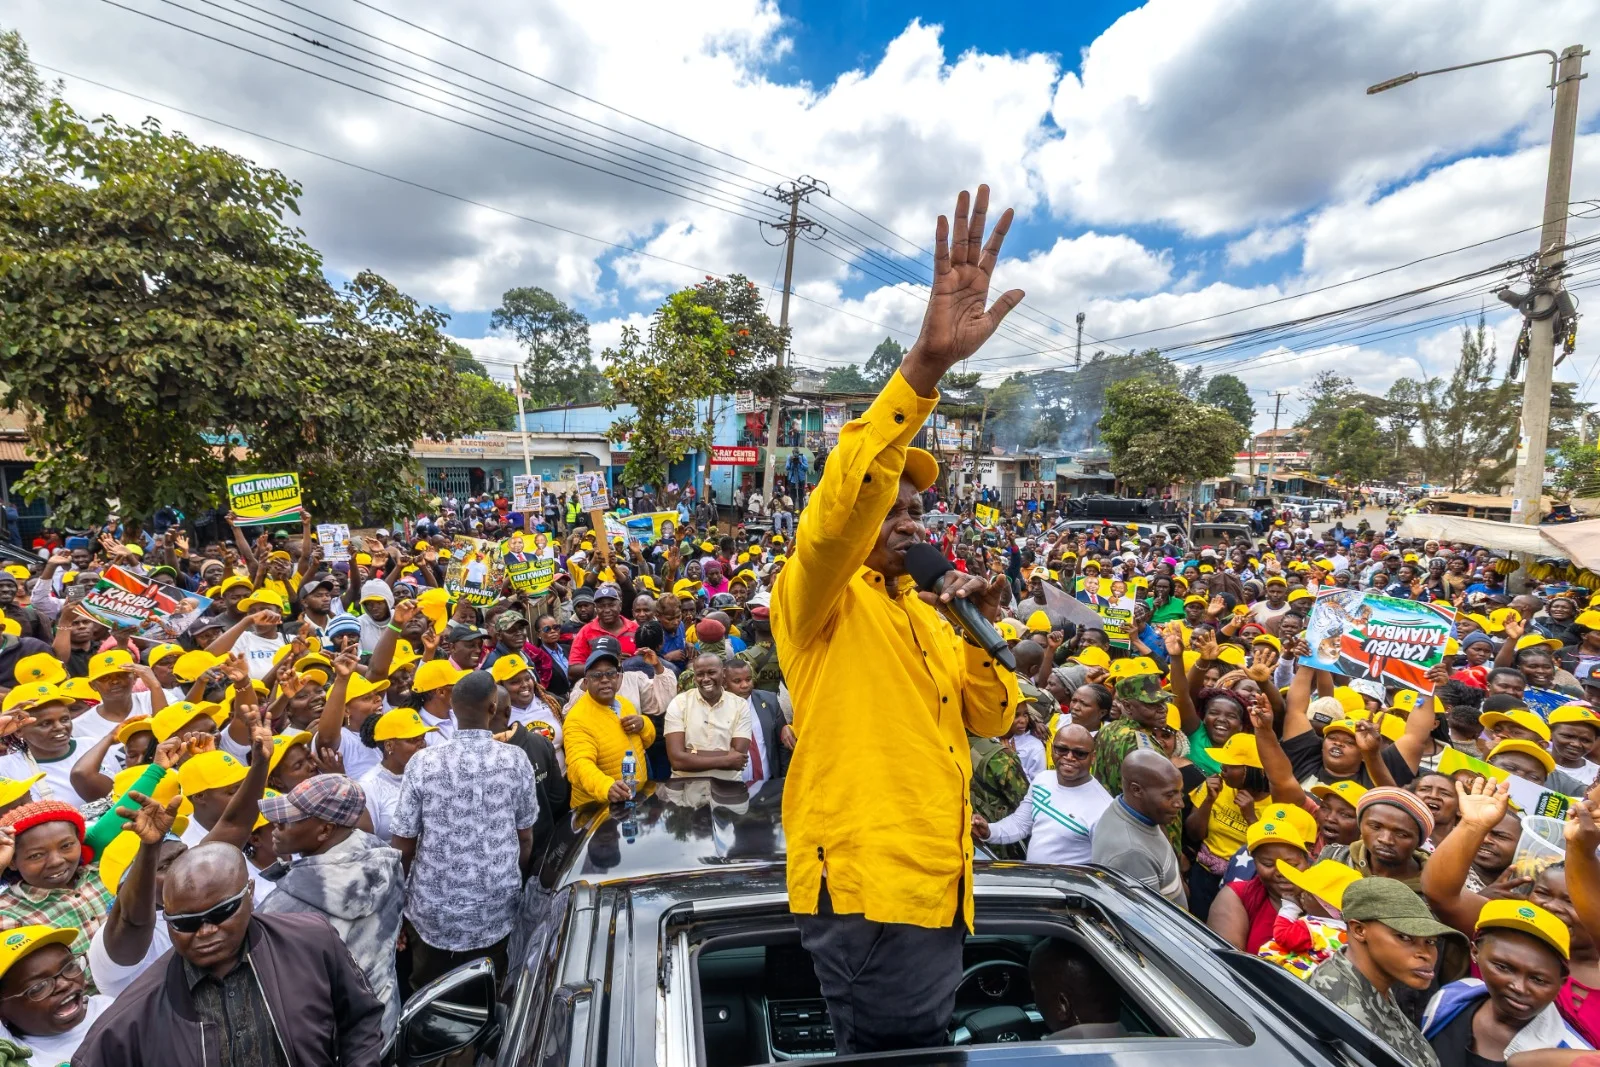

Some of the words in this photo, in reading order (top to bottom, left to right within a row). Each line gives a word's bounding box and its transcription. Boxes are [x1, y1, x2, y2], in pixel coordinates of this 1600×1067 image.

[733, 450, 756, 458] CENTER
[232, 481, 255, 495] KAZI
[256, 475, 294, 491] KWANZA
[235, 493, 261, 508] SIASA
[262, 487, 297, 503] BAADAYE
[513, 573, 527, 582] KAZI
[102, 587, 157, 609] KARIBU
[450, 584, 494, 597] KA-WANJIKU
[90, 595, 151, 619] KIAMBAA
[1367, 623, 1442, 645] KIAMBAA
[1364, 639, 1431, 661] KARIBU
